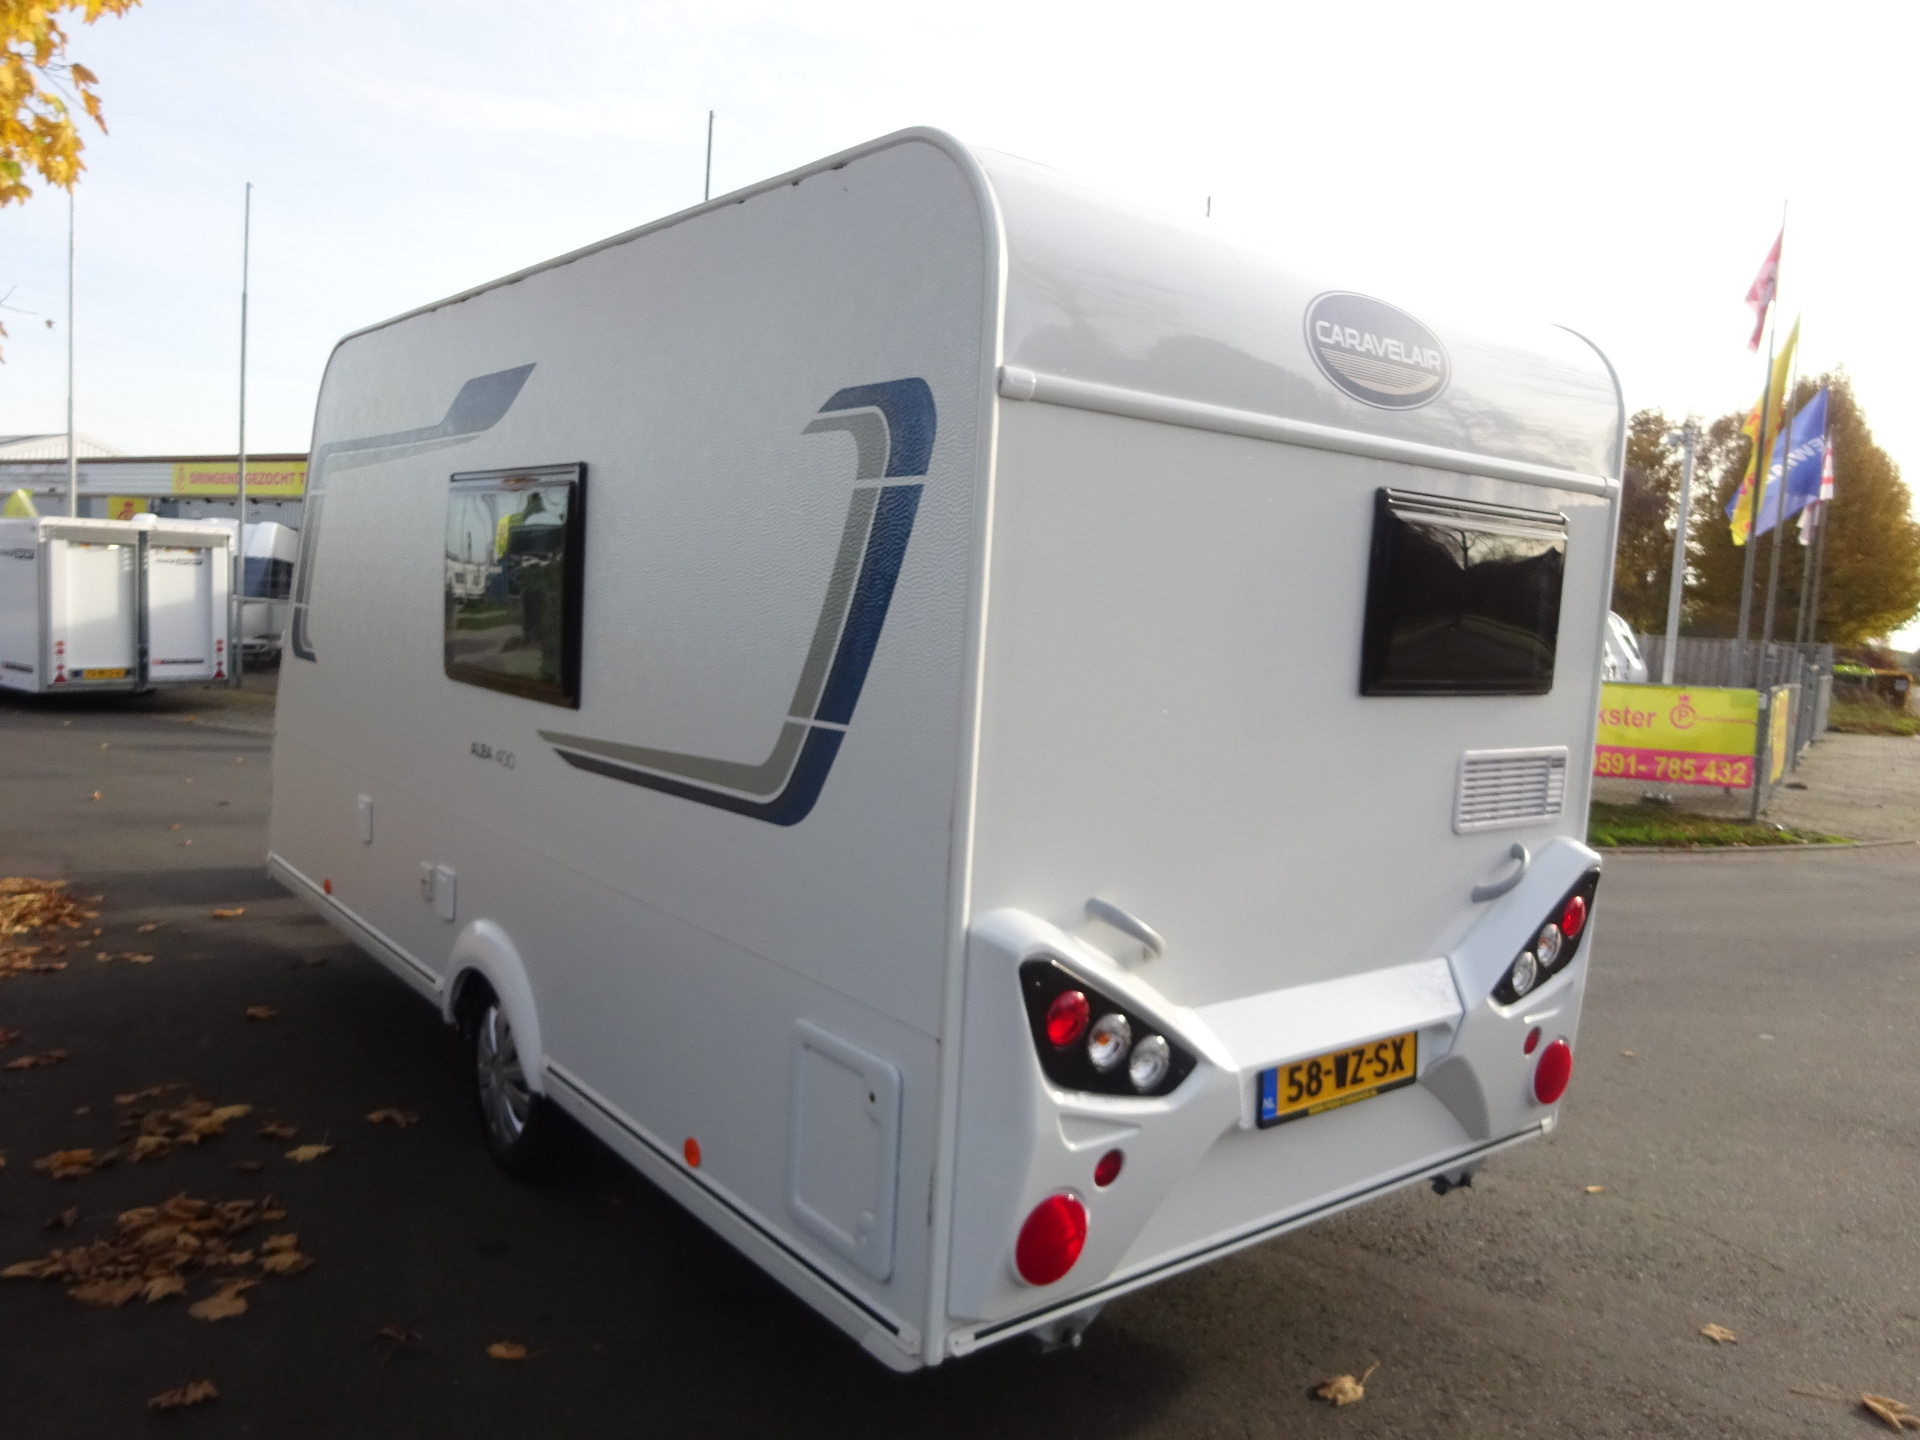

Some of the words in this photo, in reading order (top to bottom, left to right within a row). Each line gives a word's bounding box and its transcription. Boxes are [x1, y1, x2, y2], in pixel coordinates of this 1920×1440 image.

[1315, 319, 1442, 372] CARAVELAIR
[245, 471, 295, 485] GEZOCHT
[1594, 752, 1648, 775] 591-
[1654, 756, 1696, 780] 785
[1702, 761, 1747, 785] 432
